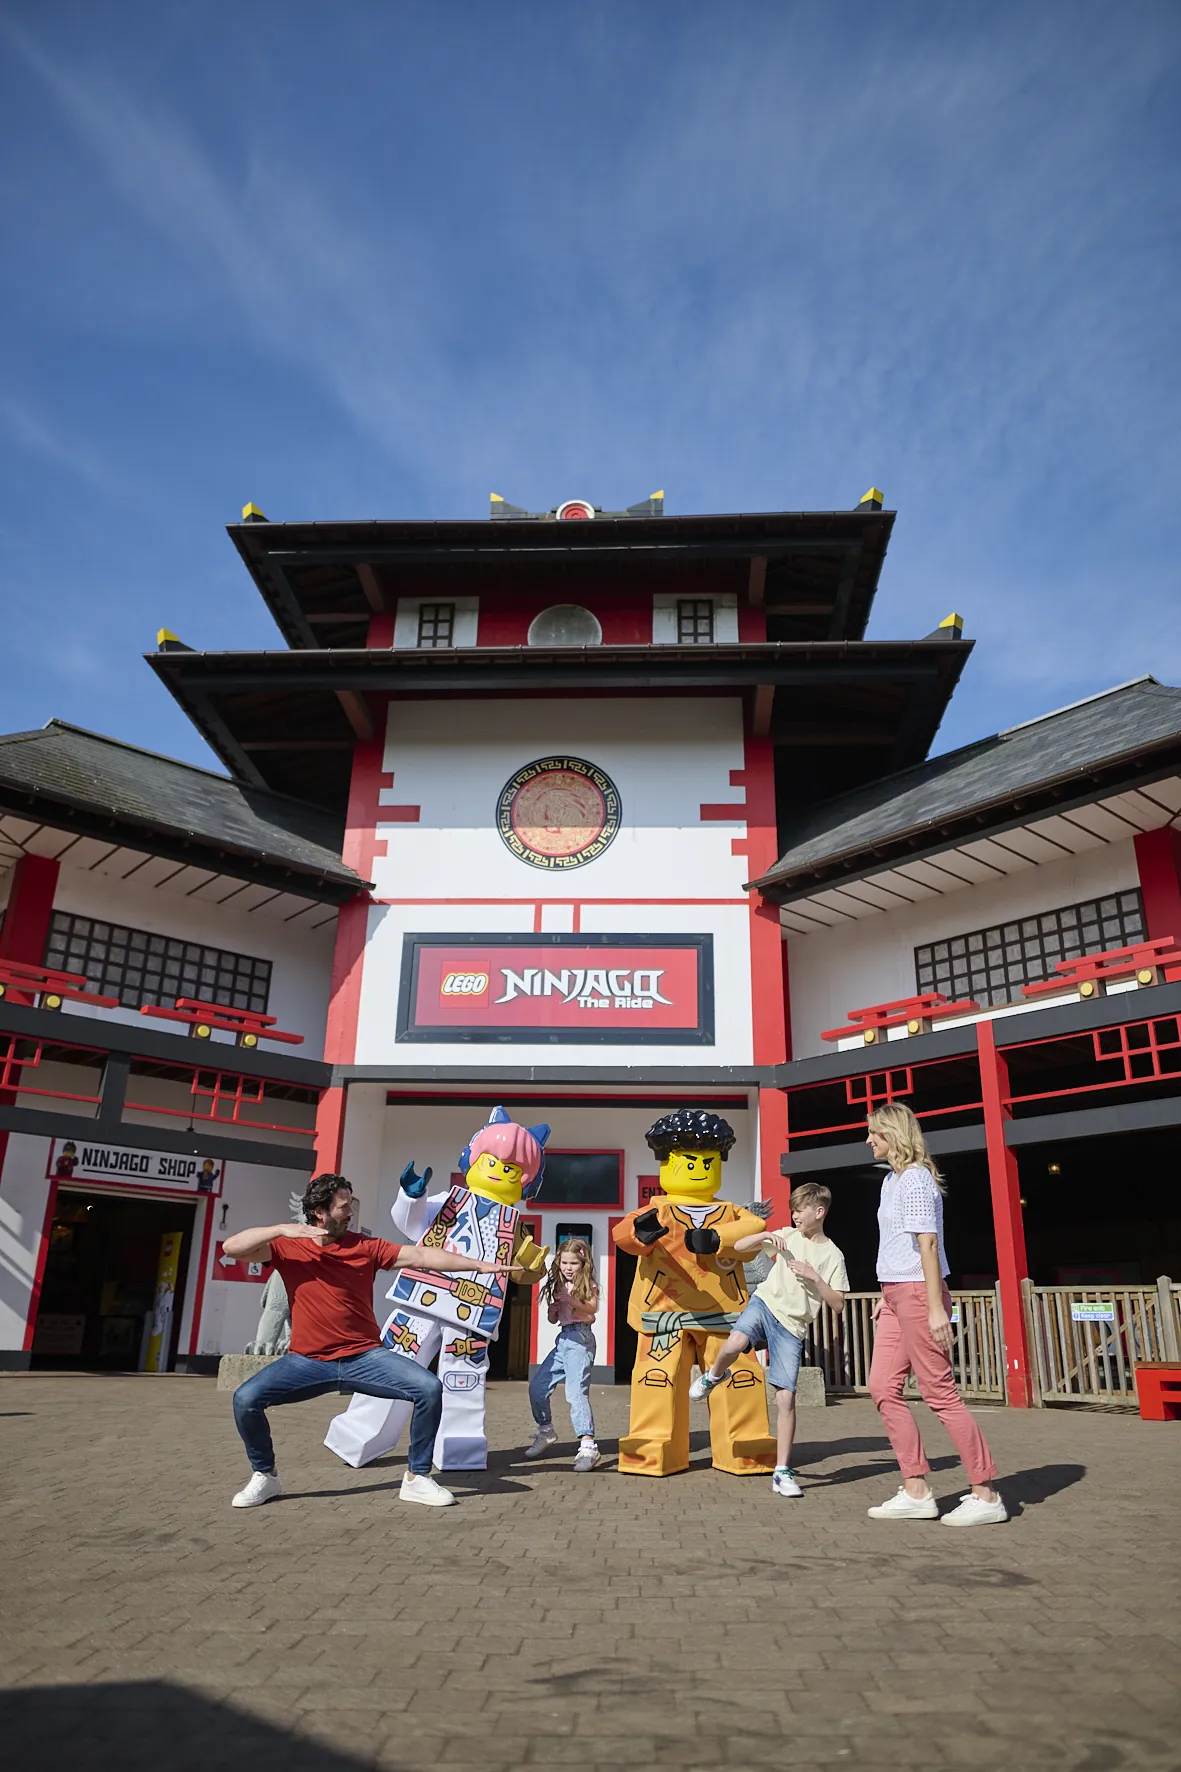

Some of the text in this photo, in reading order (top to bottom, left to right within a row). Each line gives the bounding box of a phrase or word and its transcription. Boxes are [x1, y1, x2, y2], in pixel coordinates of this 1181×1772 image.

[443, 969, 673, 1005] LEGO NINJAGO
[577, 996, 654, 1009] The Ride
[81, 1148, 196, 1178] NINJAGO SHOP
[642, 1187, 667, 1198] ENT
